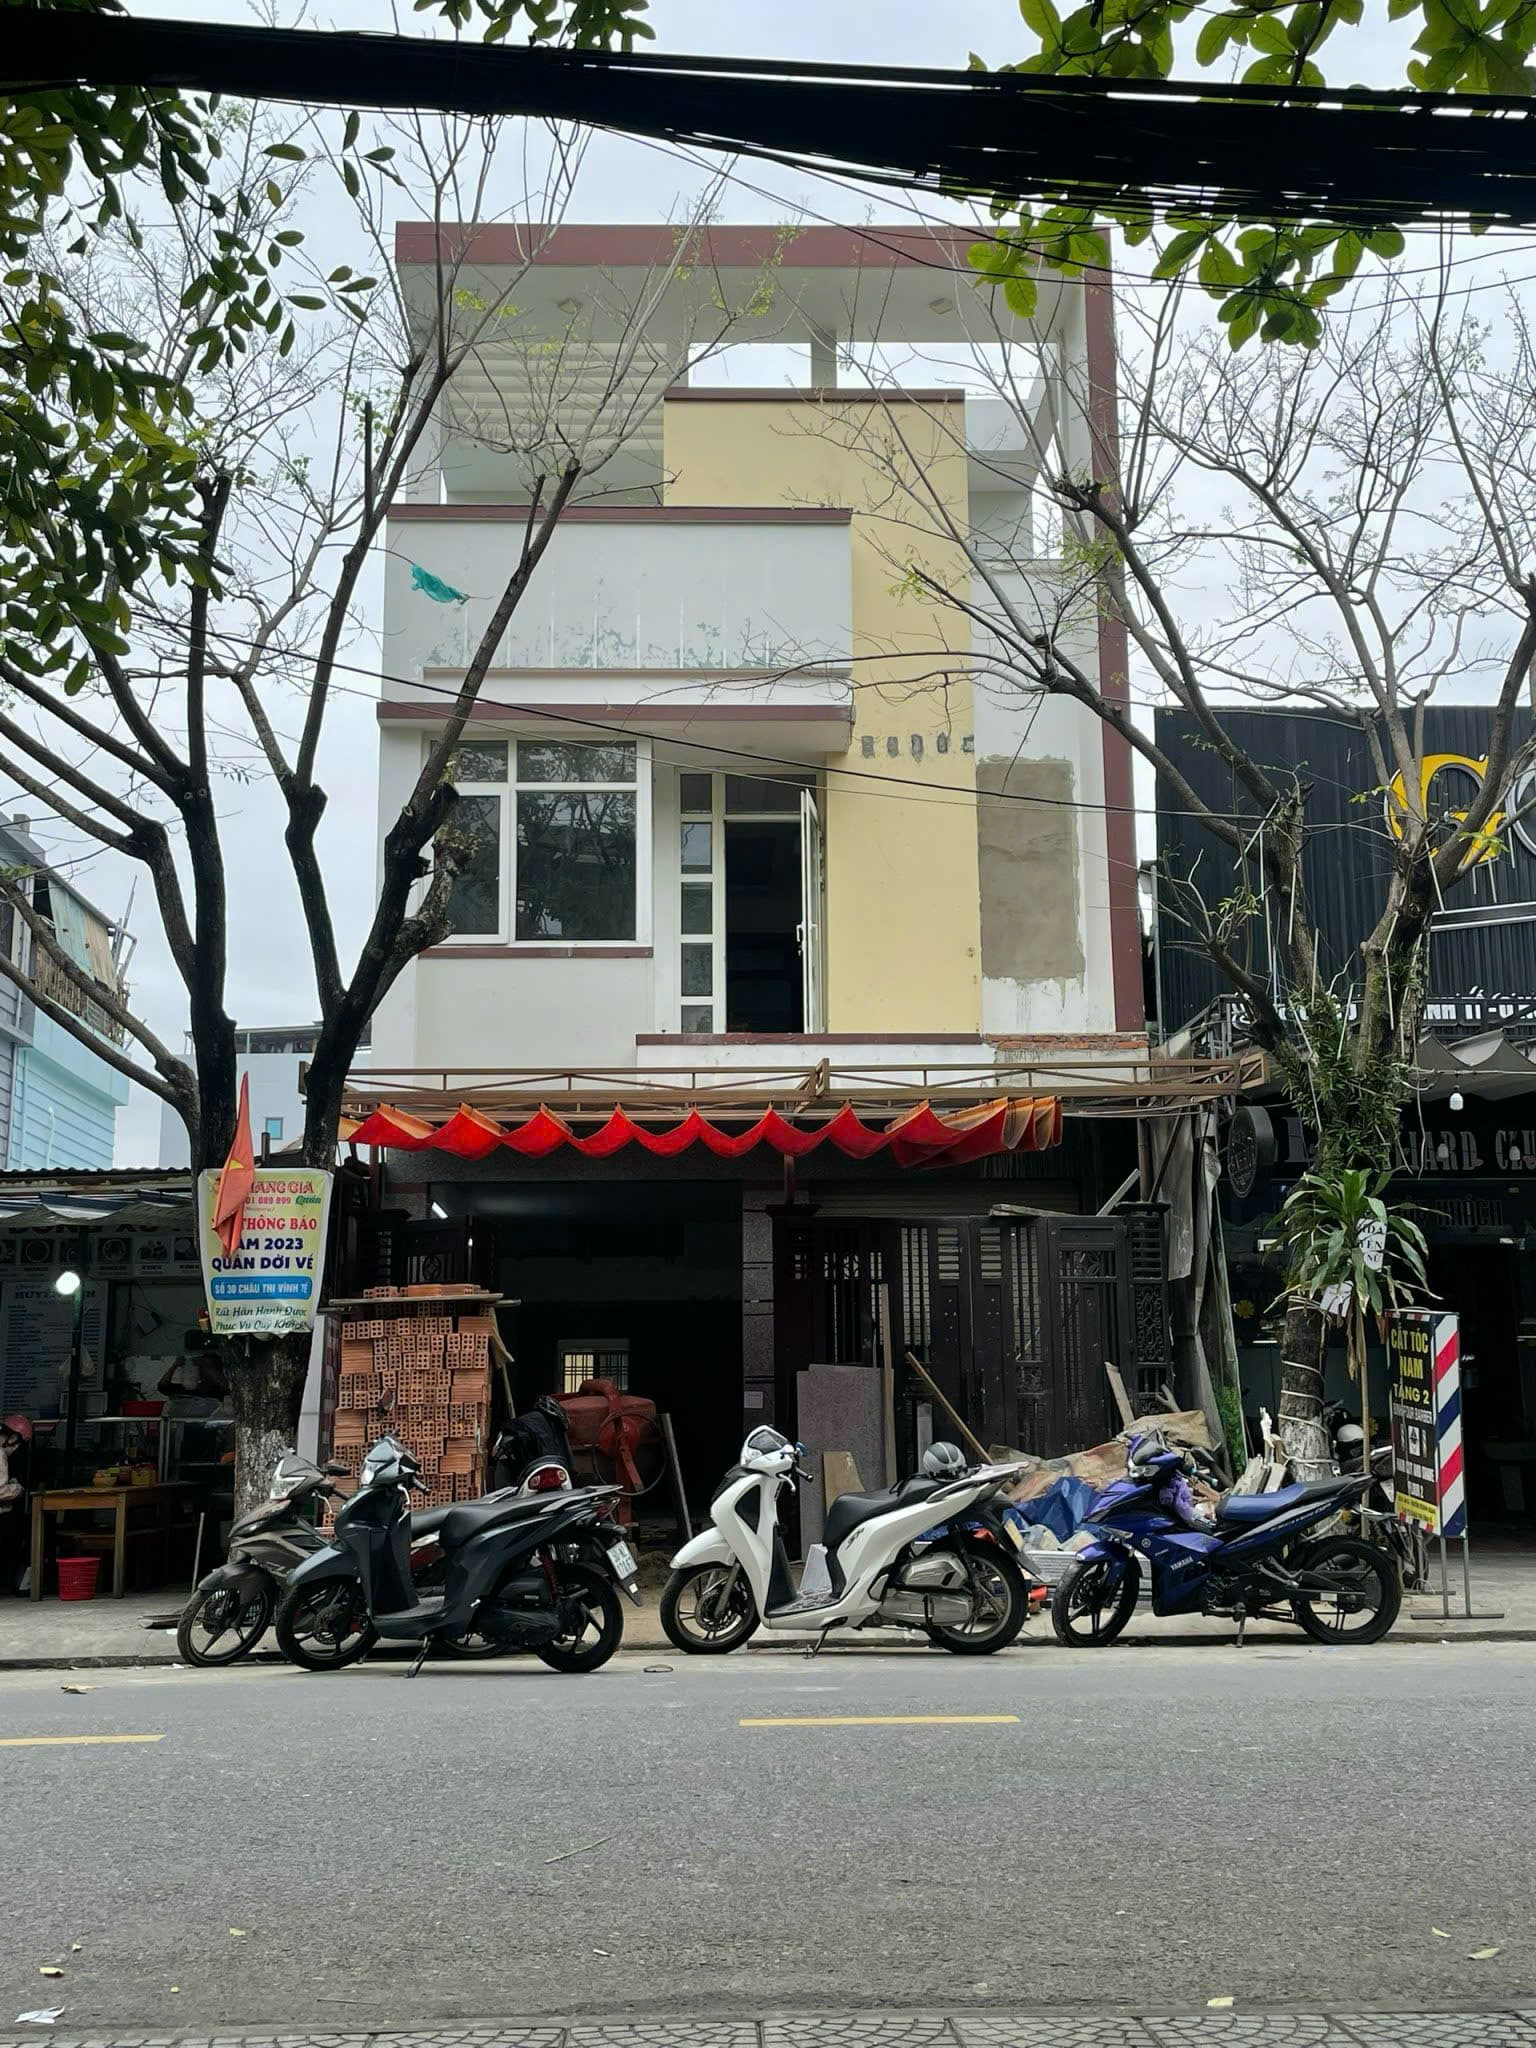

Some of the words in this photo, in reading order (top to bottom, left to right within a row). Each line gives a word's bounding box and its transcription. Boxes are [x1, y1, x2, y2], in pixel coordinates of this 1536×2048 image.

[288, 1180, 314, 1194] GIA
[290, 1214, 317, 1230] BÁO
[264, 1237, 304, 1250] 2023
[1399, 1355, 1424, 1380] NAM
[1422, 1389, 1431, 1405] 2
